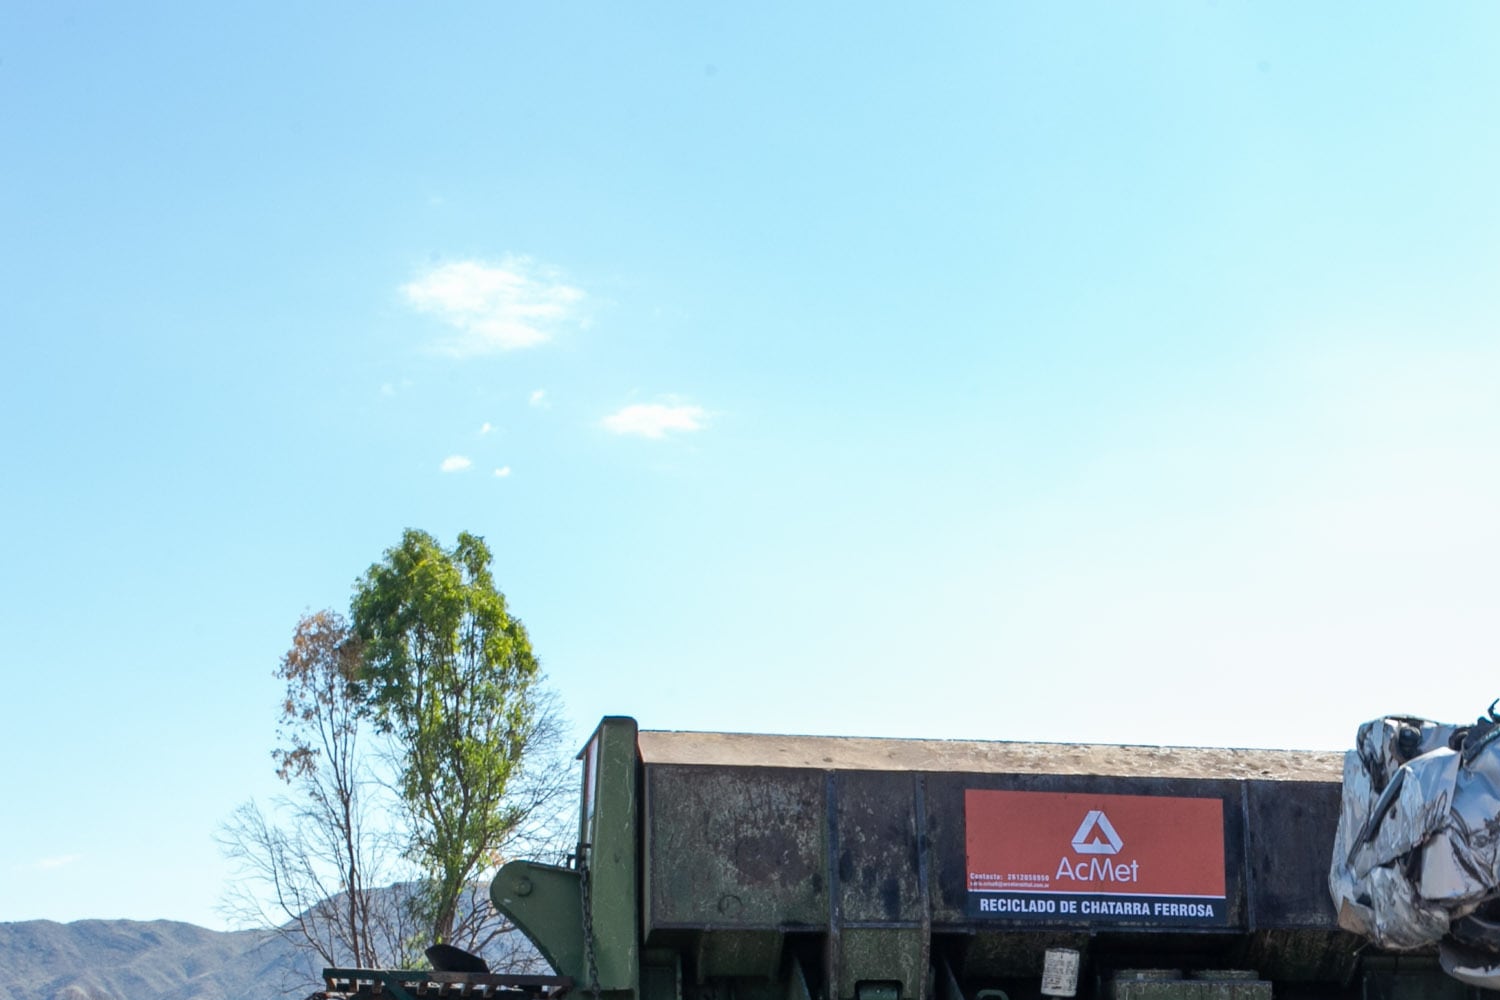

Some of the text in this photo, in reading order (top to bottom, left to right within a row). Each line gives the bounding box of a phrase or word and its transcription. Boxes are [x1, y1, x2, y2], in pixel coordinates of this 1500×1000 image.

[1055, 857, 1139, 882] AcMet
[980, 898, 1214, 917] RECICLADO DE CHATARRA FERROSA
